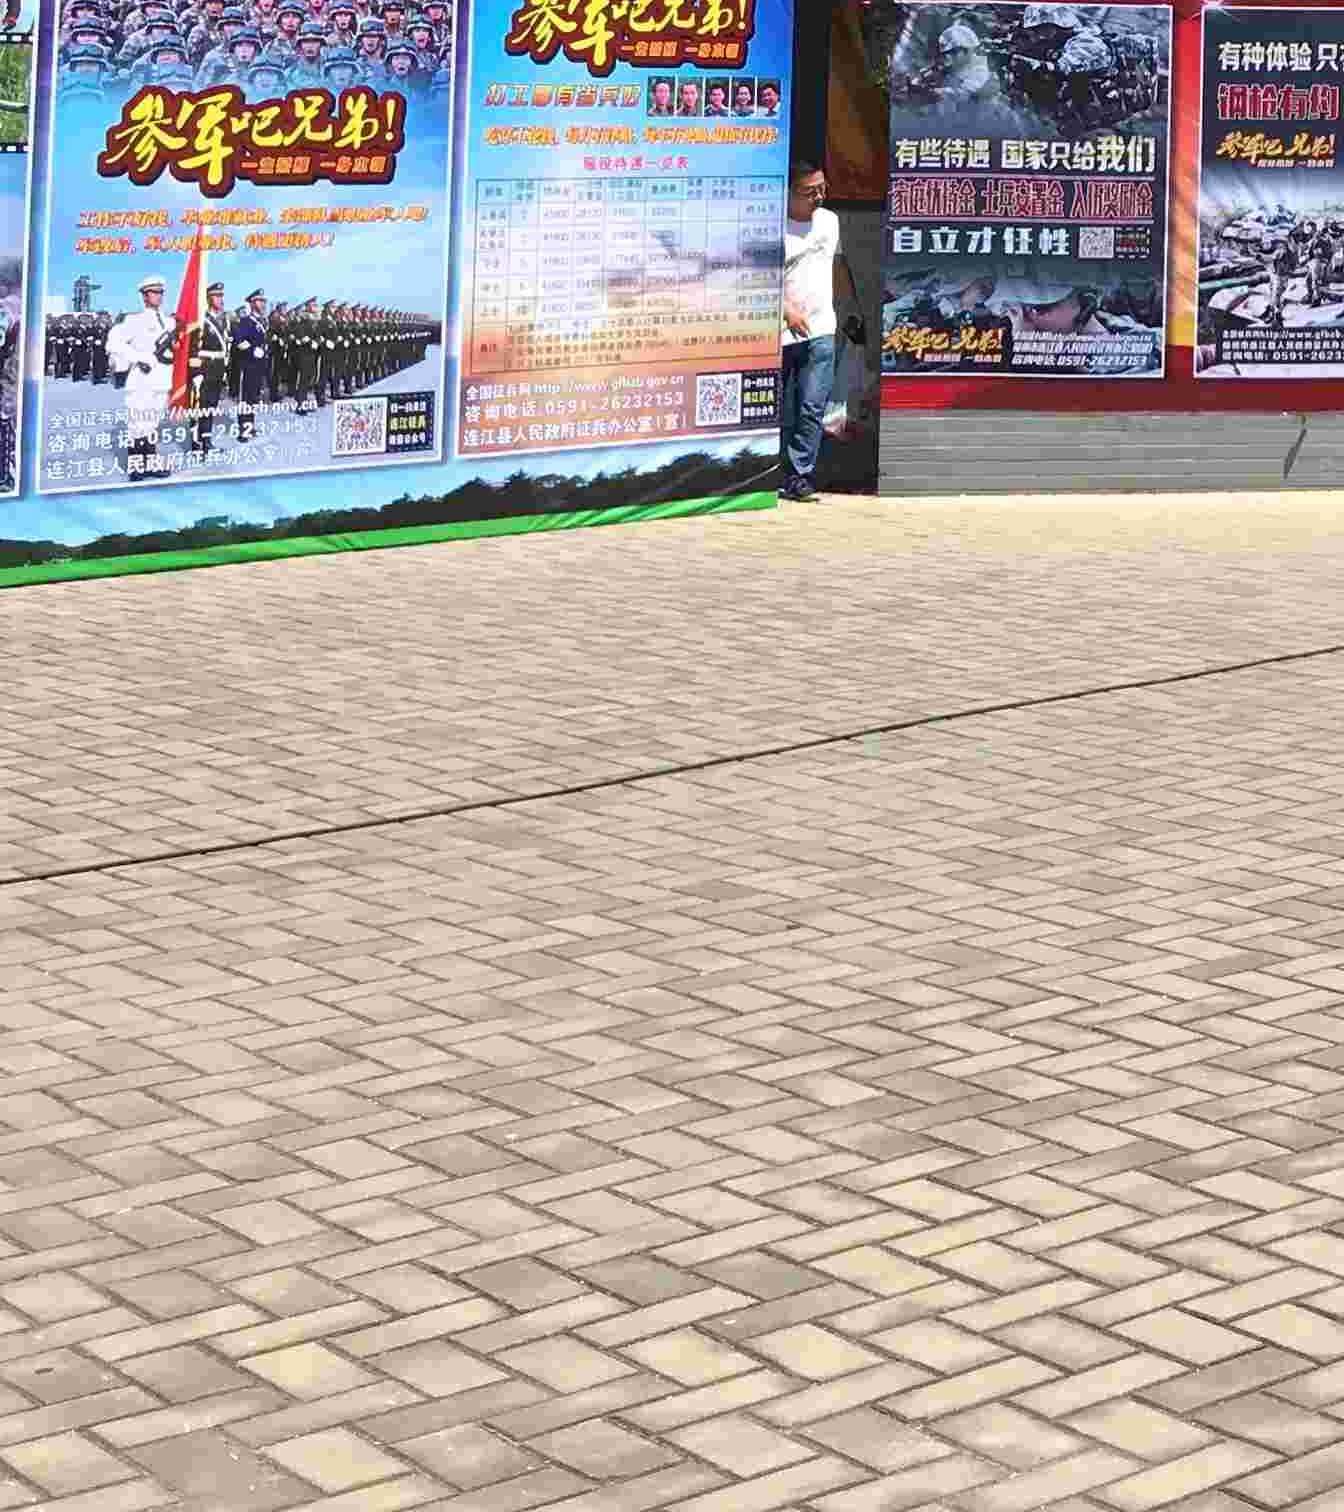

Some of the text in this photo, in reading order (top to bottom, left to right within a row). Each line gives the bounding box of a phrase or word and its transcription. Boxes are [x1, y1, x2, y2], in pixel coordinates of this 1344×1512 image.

[1218, 42, 1312, 72] 有种体验
[1216, 83, 1340, 120] 钢枪有约
[105, 92, 395, 185] 参军吧兄弟！
[896, 135, 1156, 172] 有些待遇 国家只给我们
[892, 225, 1070, 257] 自立才任性
